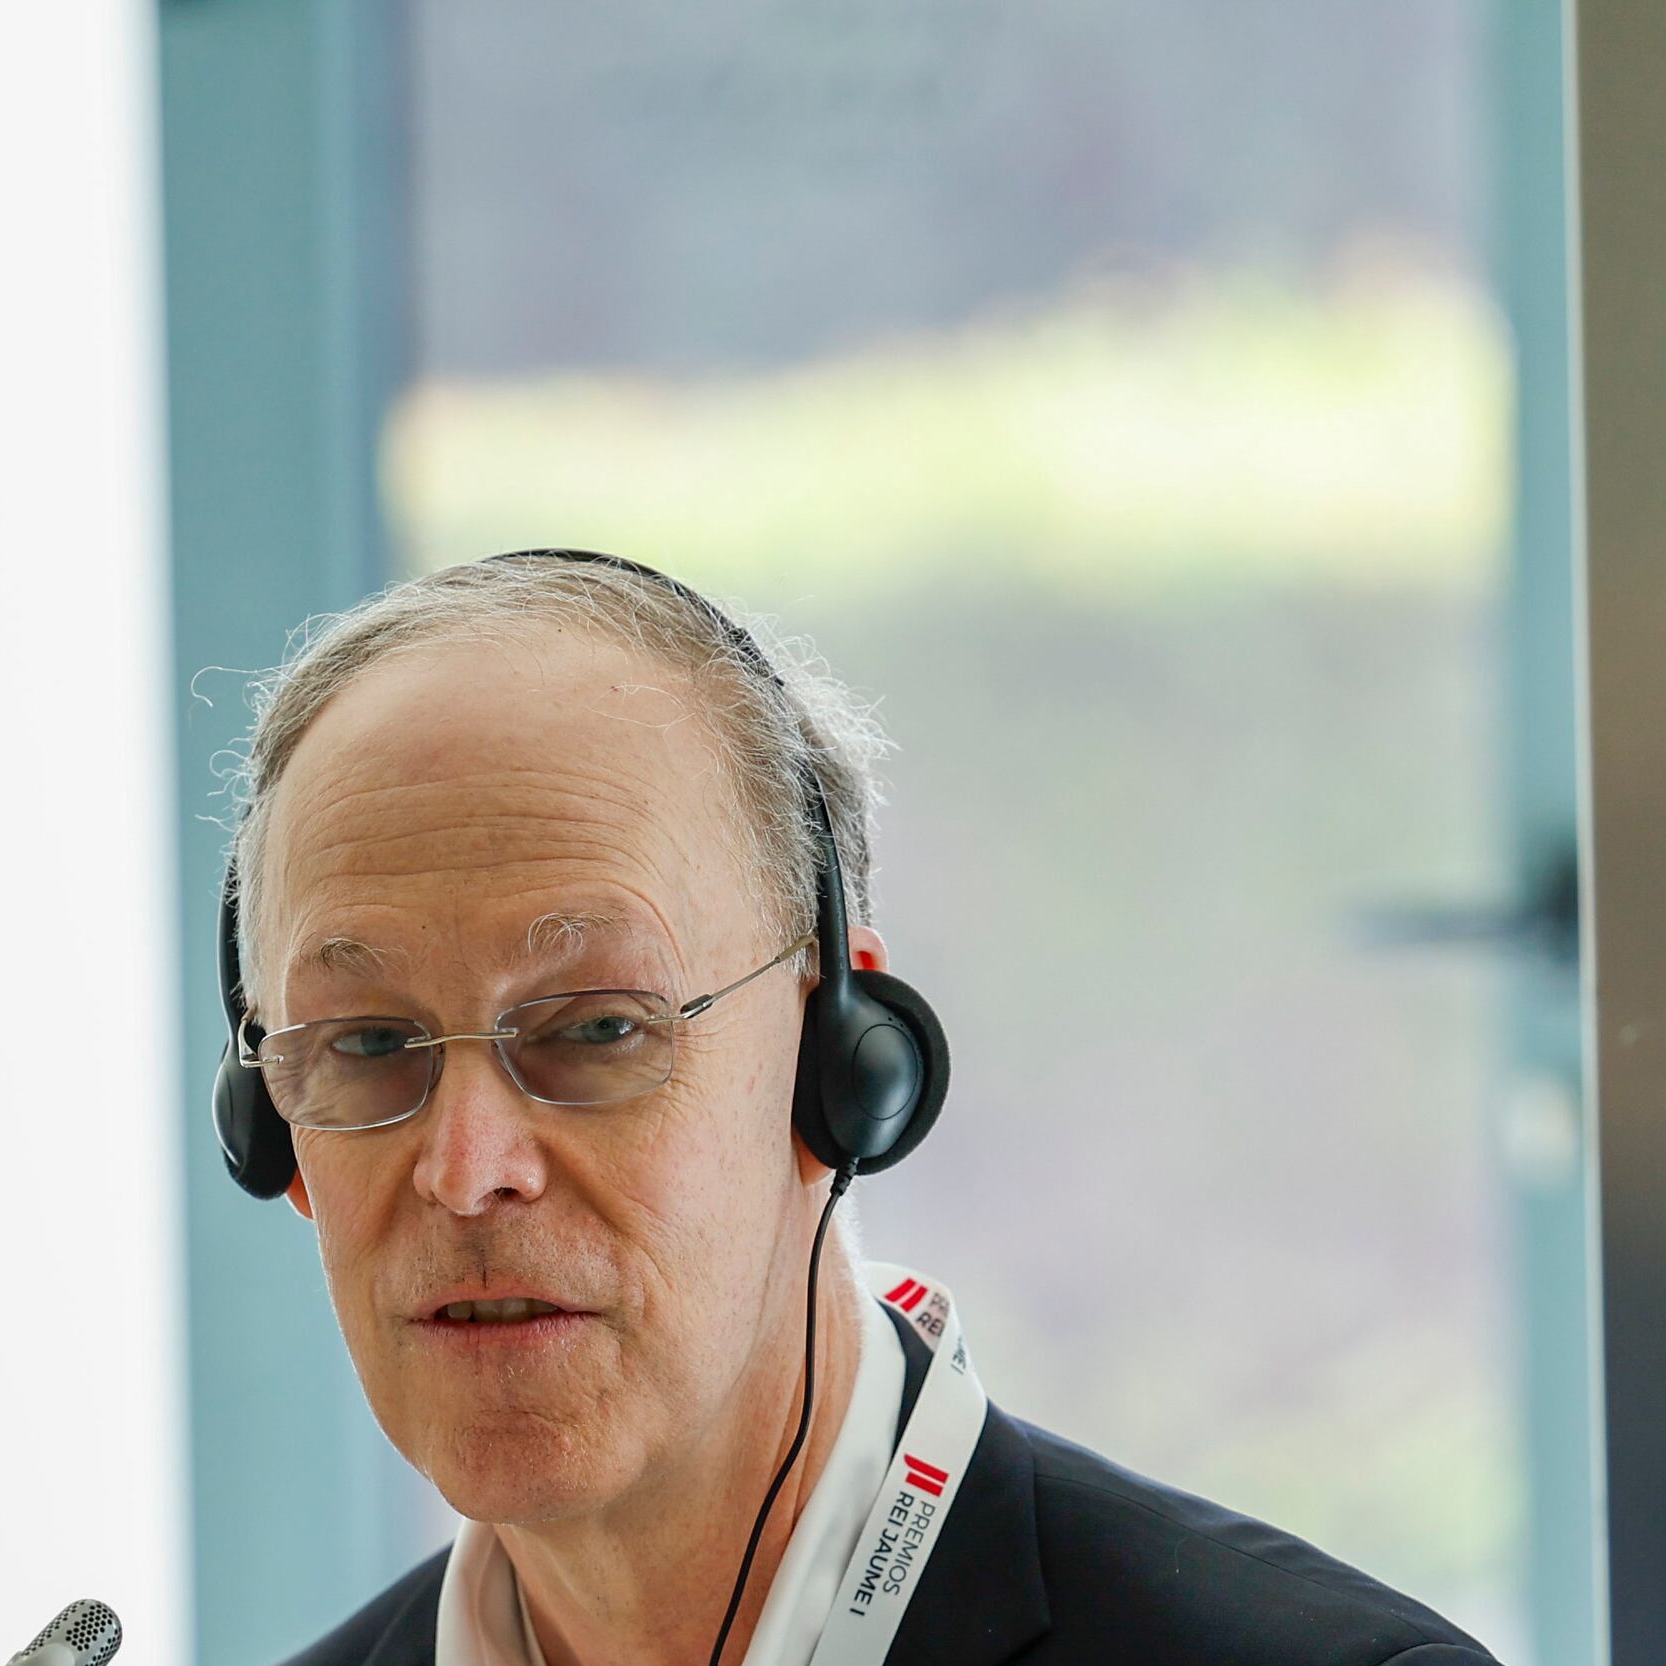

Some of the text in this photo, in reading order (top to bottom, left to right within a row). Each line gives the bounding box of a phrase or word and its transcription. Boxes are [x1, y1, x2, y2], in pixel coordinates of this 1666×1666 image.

[849, 1491, 915, 1617] REI JAUME I
[882, 1500, 936, 1596] PREMIOS
